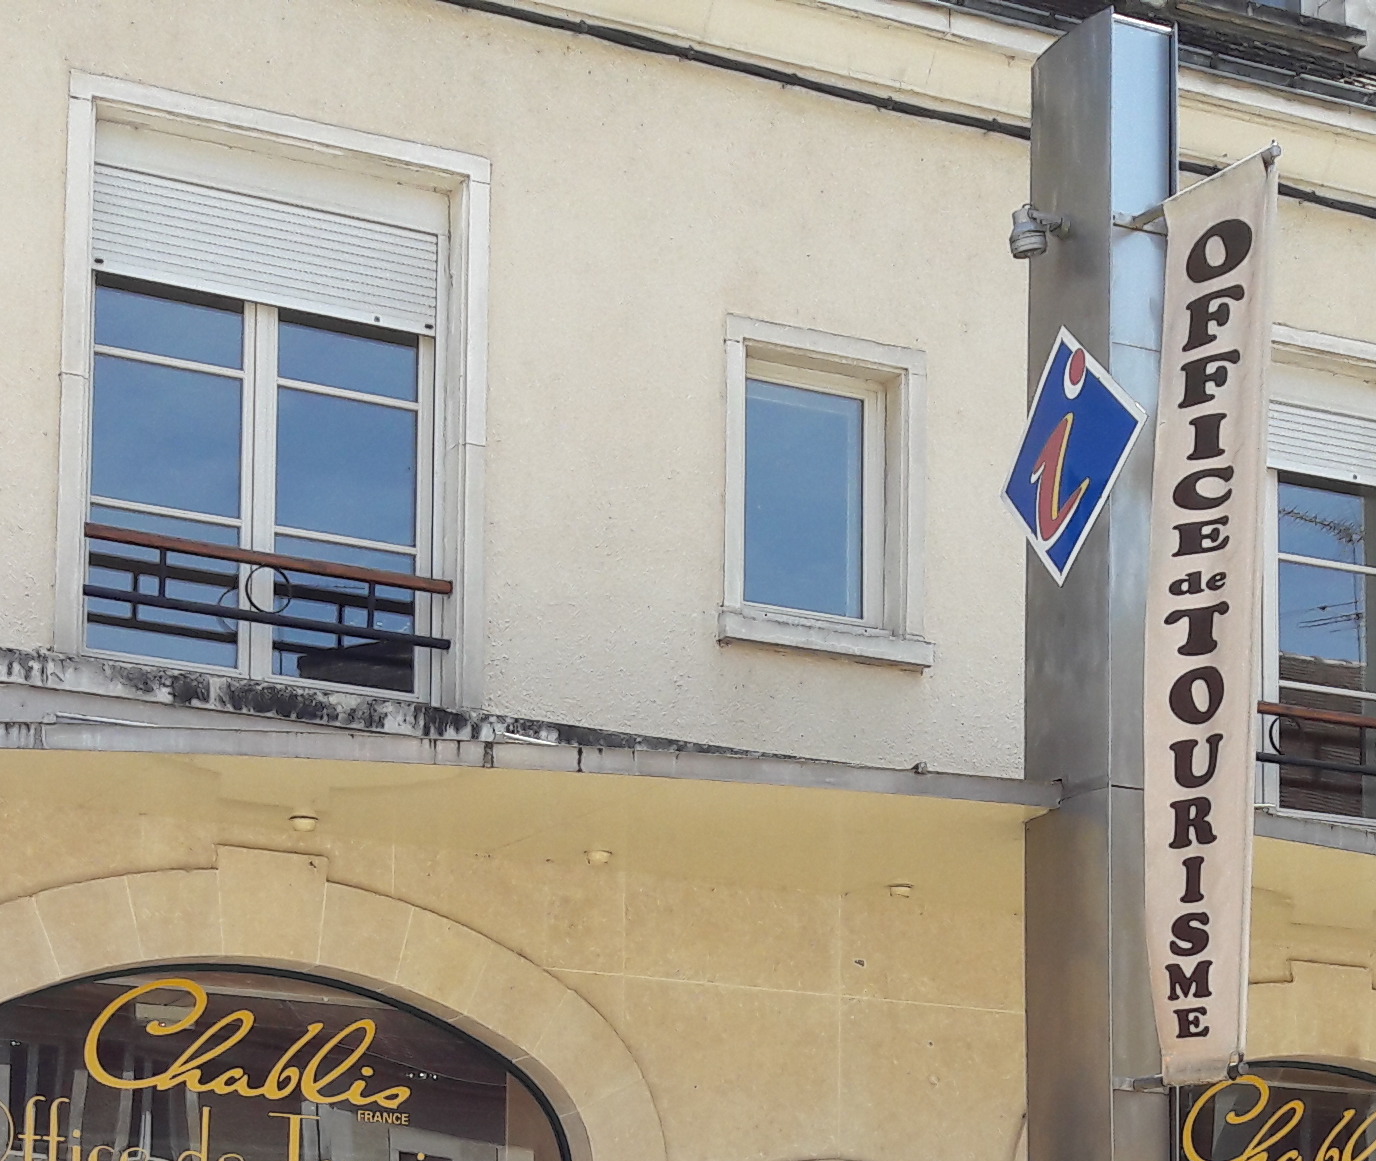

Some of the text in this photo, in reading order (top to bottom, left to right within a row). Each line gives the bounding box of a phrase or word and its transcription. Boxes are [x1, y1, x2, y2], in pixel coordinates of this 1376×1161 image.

[1163, 218, 1253, 1039] OFFICE de TOURISME
[83, 977, 412, 1109] Chablis
[356, 1109, 410, 1126] FRANCE
